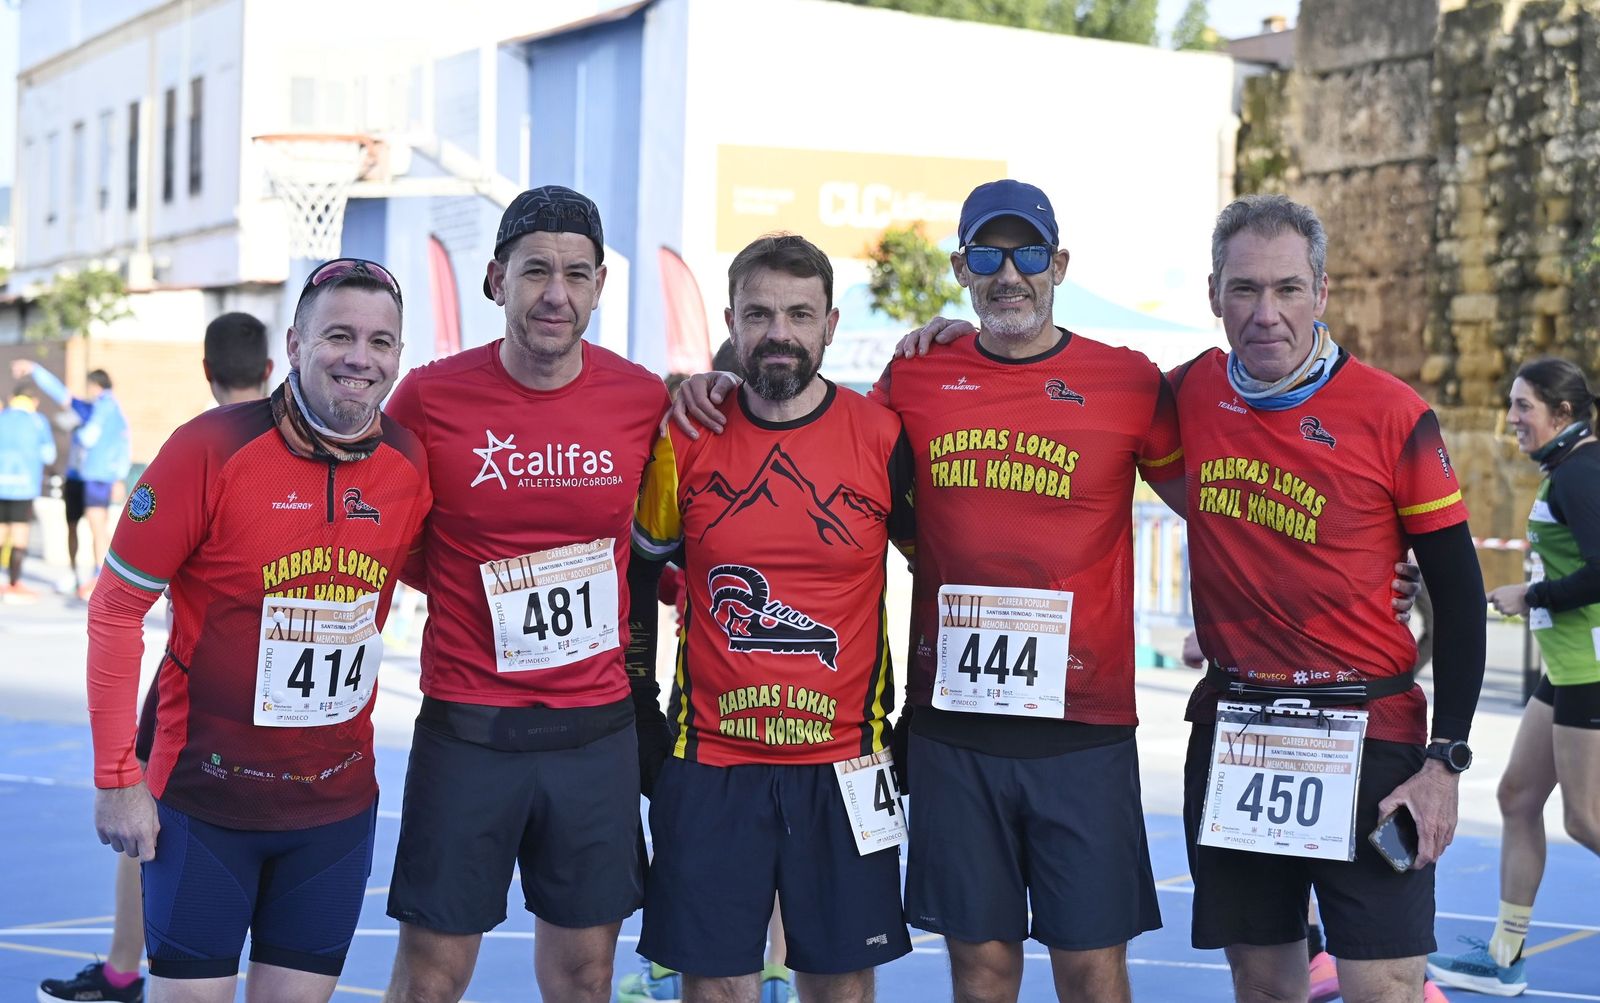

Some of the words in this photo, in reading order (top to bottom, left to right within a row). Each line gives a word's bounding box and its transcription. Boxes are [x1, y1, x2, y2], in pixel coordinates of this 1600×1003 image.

[508, 443, 614, 476] califas
[929, 428, 1010, 462] KABRAS
[1014, 431, 1080, 474] LOKAS
[930, 459, 979, 488] TRAIL
[985, 453, 1072, 500] KÓRDOBA
[1200, 457, 1270, 485] KABRAS
[1272, 467, 1327, 517] LOKAS
[272, 502, 313, 510] TEAMERGY
[1199, 487, 1242, 519] TRAIL
[1246, 488, 1318, 545] KÓRDOBA
[262, 546, 333, 590] KABRAS
[338, 547, 388, 590] LOKAS
[546, 546, 573, 560] CARRERA
[489, 555, 537, 595] XLII
[537, 573, 567, 585] MEMORIAL
[523, 581, 592, 641] 481
[943, 593, 984, 628] XLII
[997, 597, 1024, 606] CARRERA
[1024, 599, 1050, 608] POPULAR
[316, 634, 348, 644] MEMORIAL
[982, 620, 1012, 630] MEMORIAL
[1012, 621, 1039, 631] "ADOLFO
[1040, 623, 1063, 633] RIVERA"
[287, 644, 365, 698] 414
[958, 633, 1038, 686] 444
[718, 684, 781, 718] KABRAS
[787, 685, 837, 721] LOKAS
[719, 717, 760, 741] TRAIL
[765, 710, 834, 746] KÓRDOBA
[1281, 736, 1308, 747] CARRERA
[1309, 738, 1337, 749] POPULAR
[1220, 732, 1267, 768] XLII
[1266, 760, 1297, 771] MEMORIAL
[1298, 762, 1325, 772] "ADOLFO
[1236, 772, 1323, 827] 450
